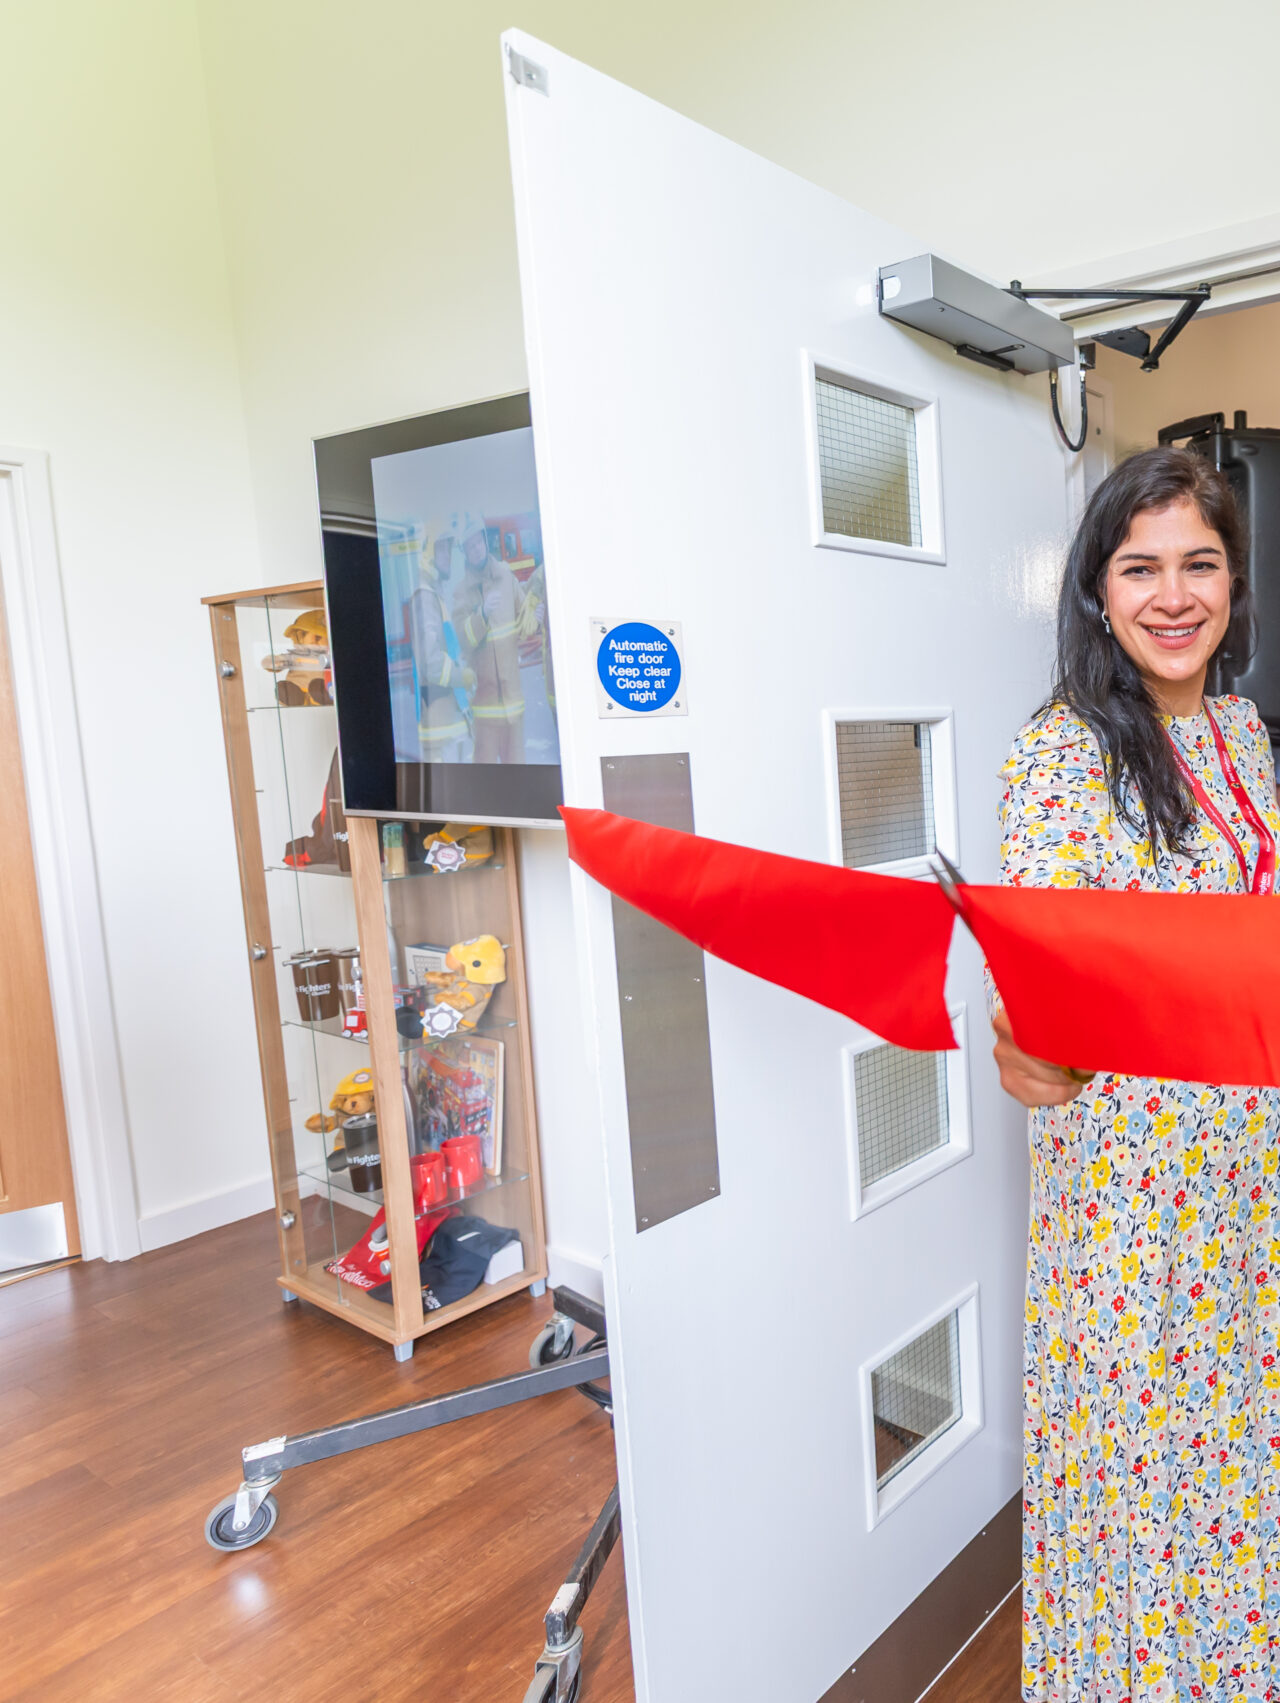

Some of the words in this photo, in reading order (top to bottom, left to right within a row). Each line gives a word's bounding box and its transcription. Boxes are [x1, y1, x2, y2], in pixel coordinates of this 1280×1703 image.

[608, 639, 668, 651] Automatic
[614, 652, 634, 664] fire
[638, 653, 664, 664] door
[608, 665, 640, 678] Keep
[643, 666, 672, 677] clear
[616, 678, 650, 689] Close
[654, 679, 666, 689] at
[629, 691, 657, 704] night
[1258, 871, 1268, 897] Fighters
[299, 983, 331, 995] Fighters
